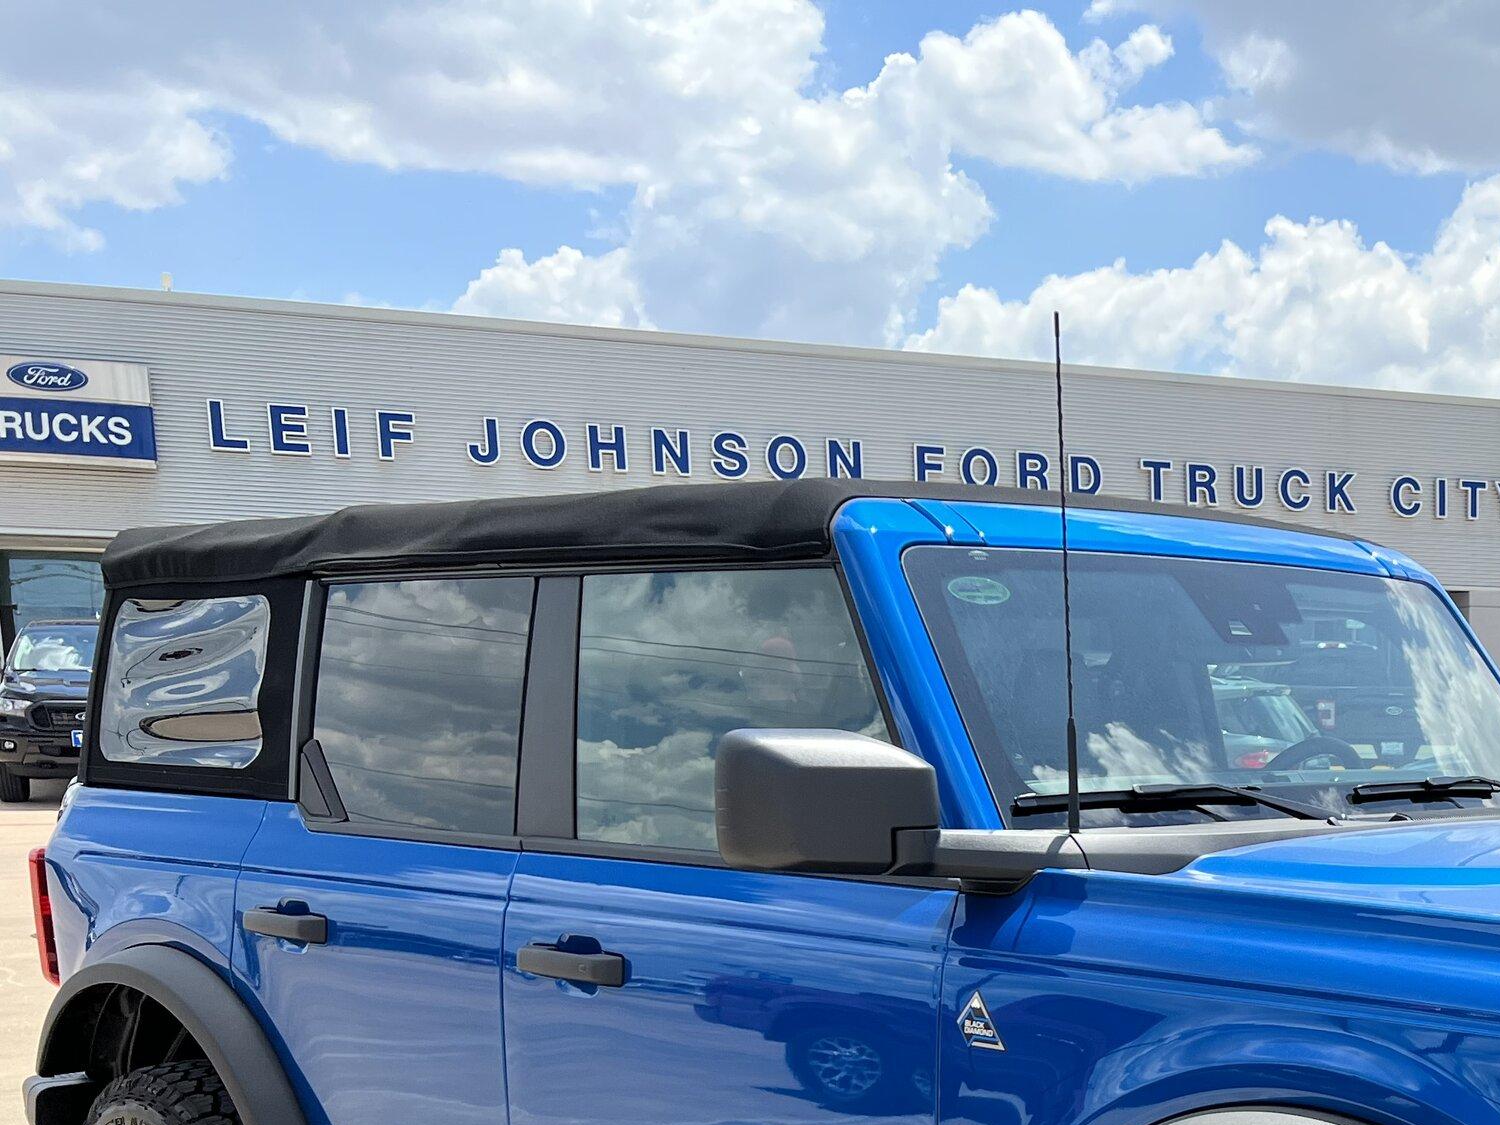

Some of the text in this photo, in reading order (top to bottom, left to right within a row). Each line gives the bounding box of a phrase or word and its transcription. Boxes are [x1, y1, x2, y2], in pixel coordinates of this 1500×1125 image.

[23, 366, 72, 387] Ford
[206, 398, 416, 461] LEIF
[466, 416, 864, 481] JOHNSON
[913, 443, 1102, 496] FORD
[1139, 458, 1358, 515] TRUCK
[963, 1026, 994, 1038] DIAMOND
[964, 1019, 986, 1029] BLACK
